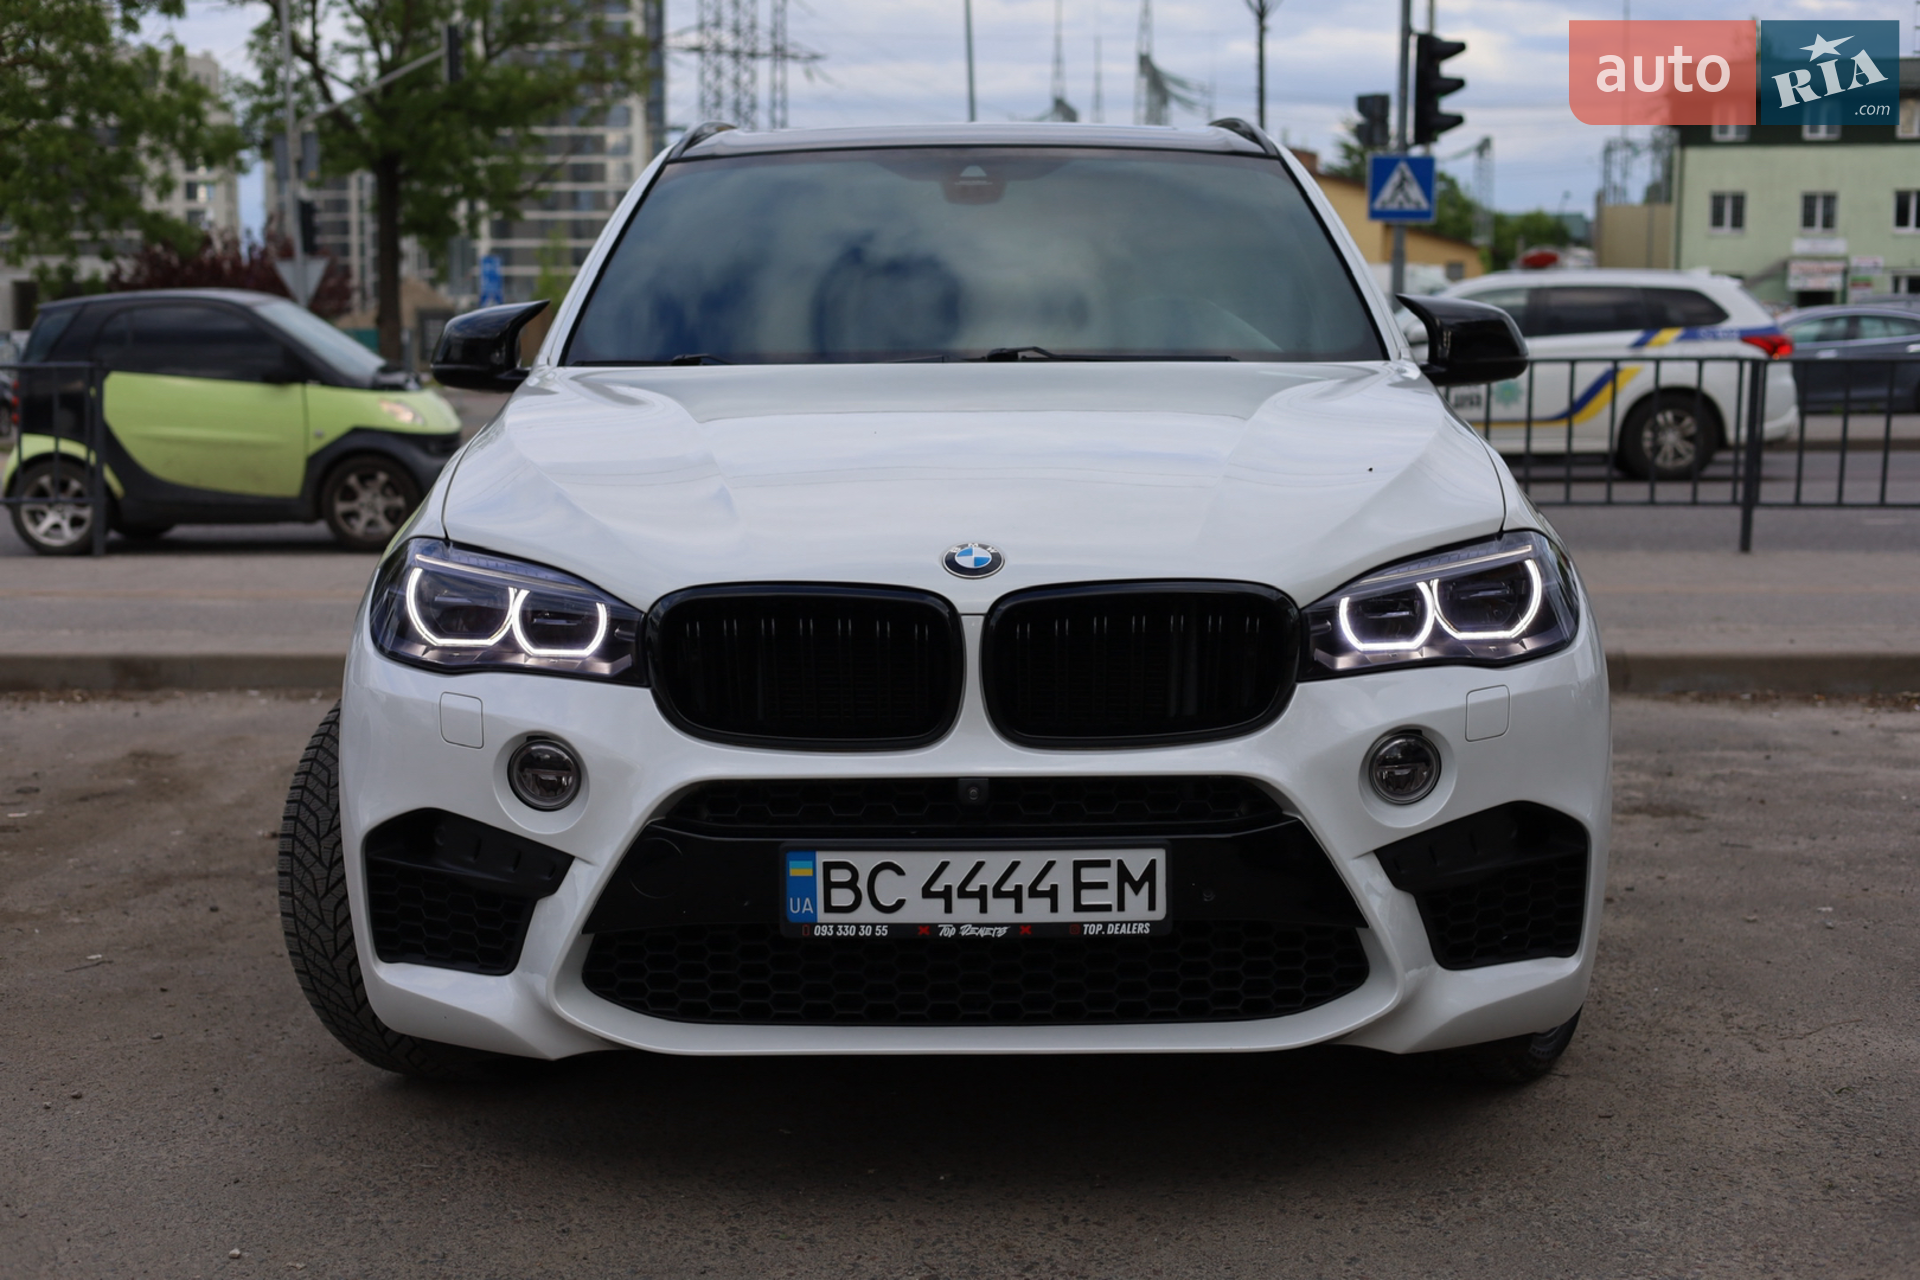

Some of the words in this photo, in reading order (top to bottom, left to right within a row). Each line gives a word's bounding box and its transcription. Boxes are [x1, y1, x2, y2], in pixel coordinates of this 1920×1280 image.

[822, 859, 907, 914] BC
[921, 859, 1059, 914] 4444
[1072, 857, 1157, 913] EM
[789, 896, 814, 914] UA
[814, 925, 834, 937] 093
[836, 925, 856, 937] 330
[858, 925, 873, 937] 30
[875, 925, 889, 937] 55
